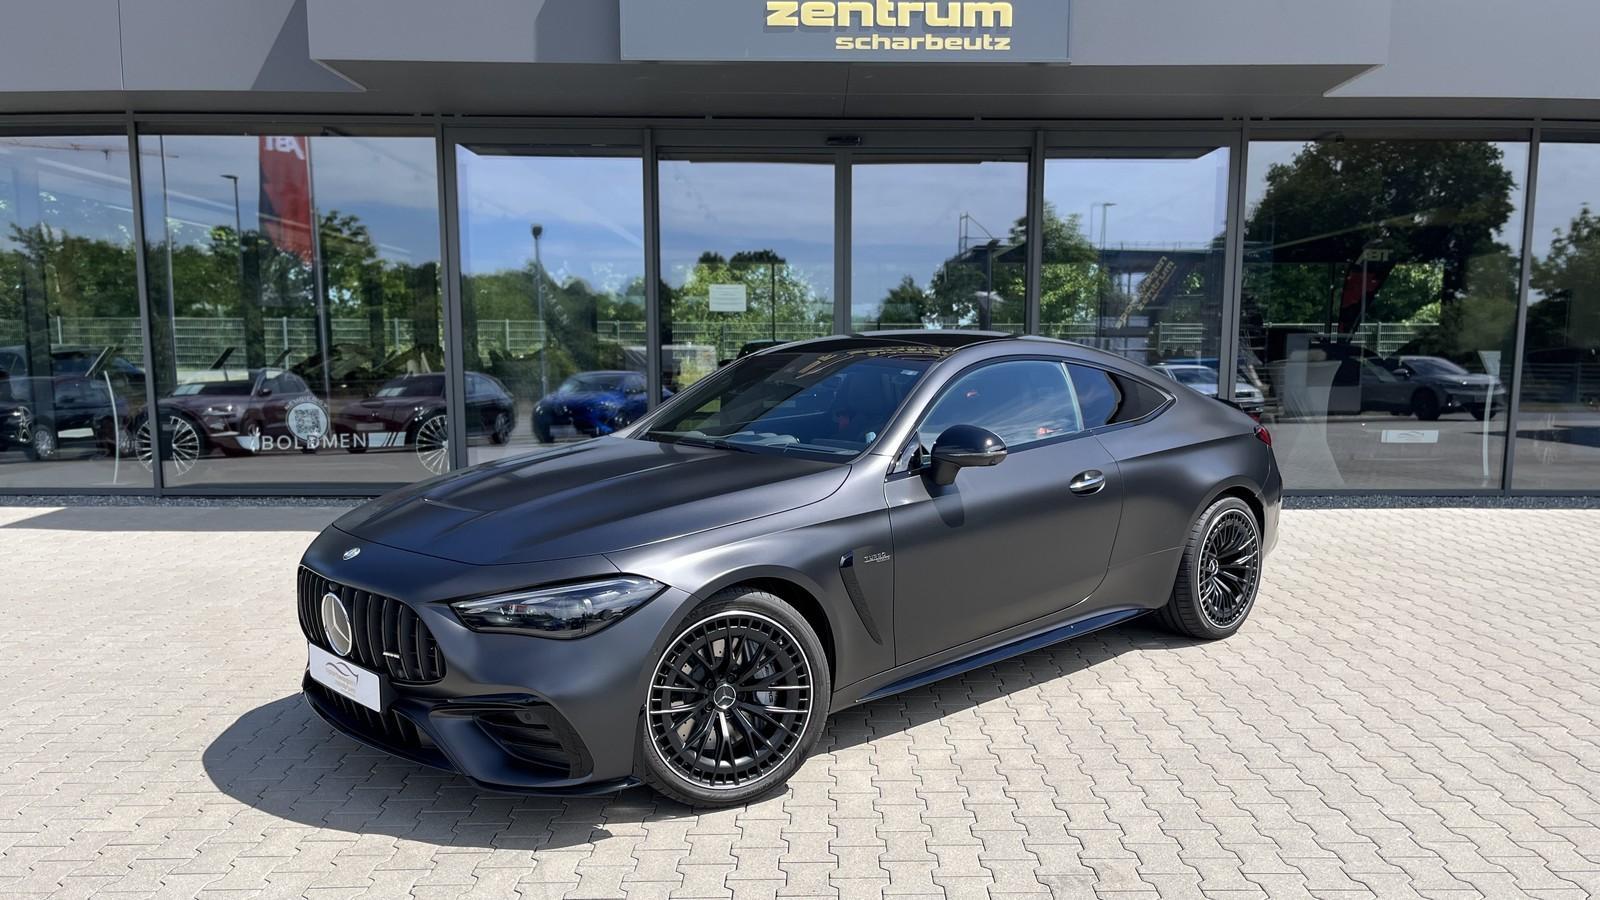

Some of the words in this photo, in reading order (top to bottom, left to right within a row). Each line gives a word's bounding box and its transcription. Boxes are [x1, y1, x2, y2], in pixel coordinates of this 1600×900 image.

[766, 0, 1013, 27] zentrum
[835, 34, 1011, 50] scharbeutz
[261, 432, 366, 450] BOLDMEN
